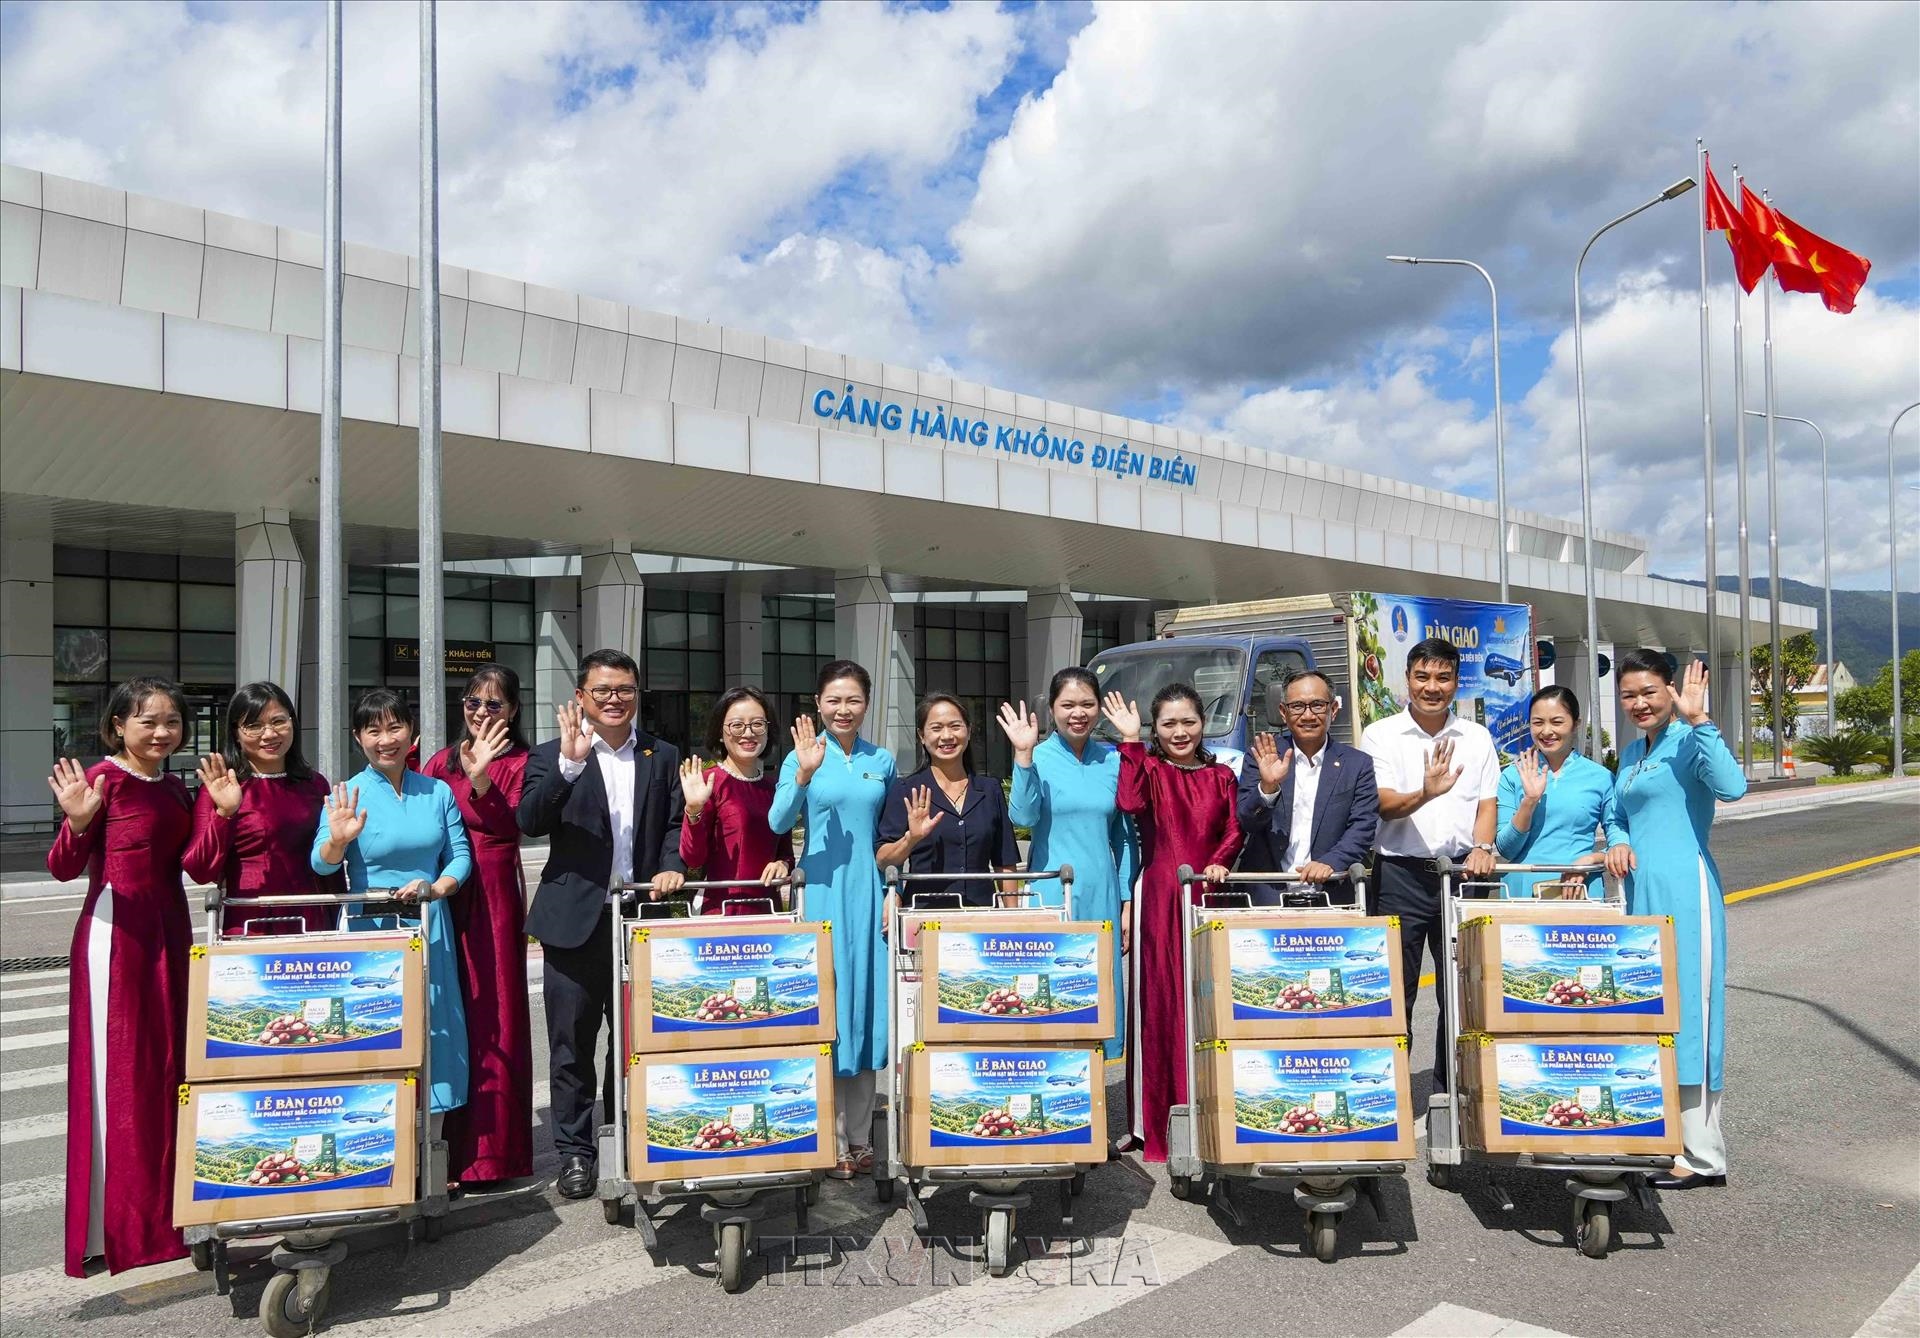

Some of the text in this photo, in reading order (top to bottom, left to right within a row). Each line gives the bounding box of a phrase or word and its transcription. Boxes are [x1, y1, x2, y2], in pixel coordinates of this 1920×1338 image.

[813, 384, 1197, 486] CẢNG HÀNG KHÔNG ĐIỆN BIÊN
[1451, 626, 1479, 648] GIAO
[1273, 933, 1344, 945] LỄ BÀN GIAO
[1545, 930, 1559, 942] LỄ
[1561, 931, 1584, 942] BÀN
[1587, 933, 1616, 942] GIAO
[698, 942, 772, 955] LỄ BÀN GIAO
[983, 938, 1055, 950] LỄ BÀN GIAO
[265, 960, 352, 973] LỄ BÀN GIAO
[1278, 1055, 1350, 1067] LỄ BÀN GIAO
[1541, 1050, 1615, 1062] LỄ BÀN GIAO
[975, 1058, 1047, 1070] LỄ BÀN GIAO
[694, 1068, 770, 1082] LỄ BÀN GIAO
[255, 1095, 343, 1110] LỄ BÀN GIAO
